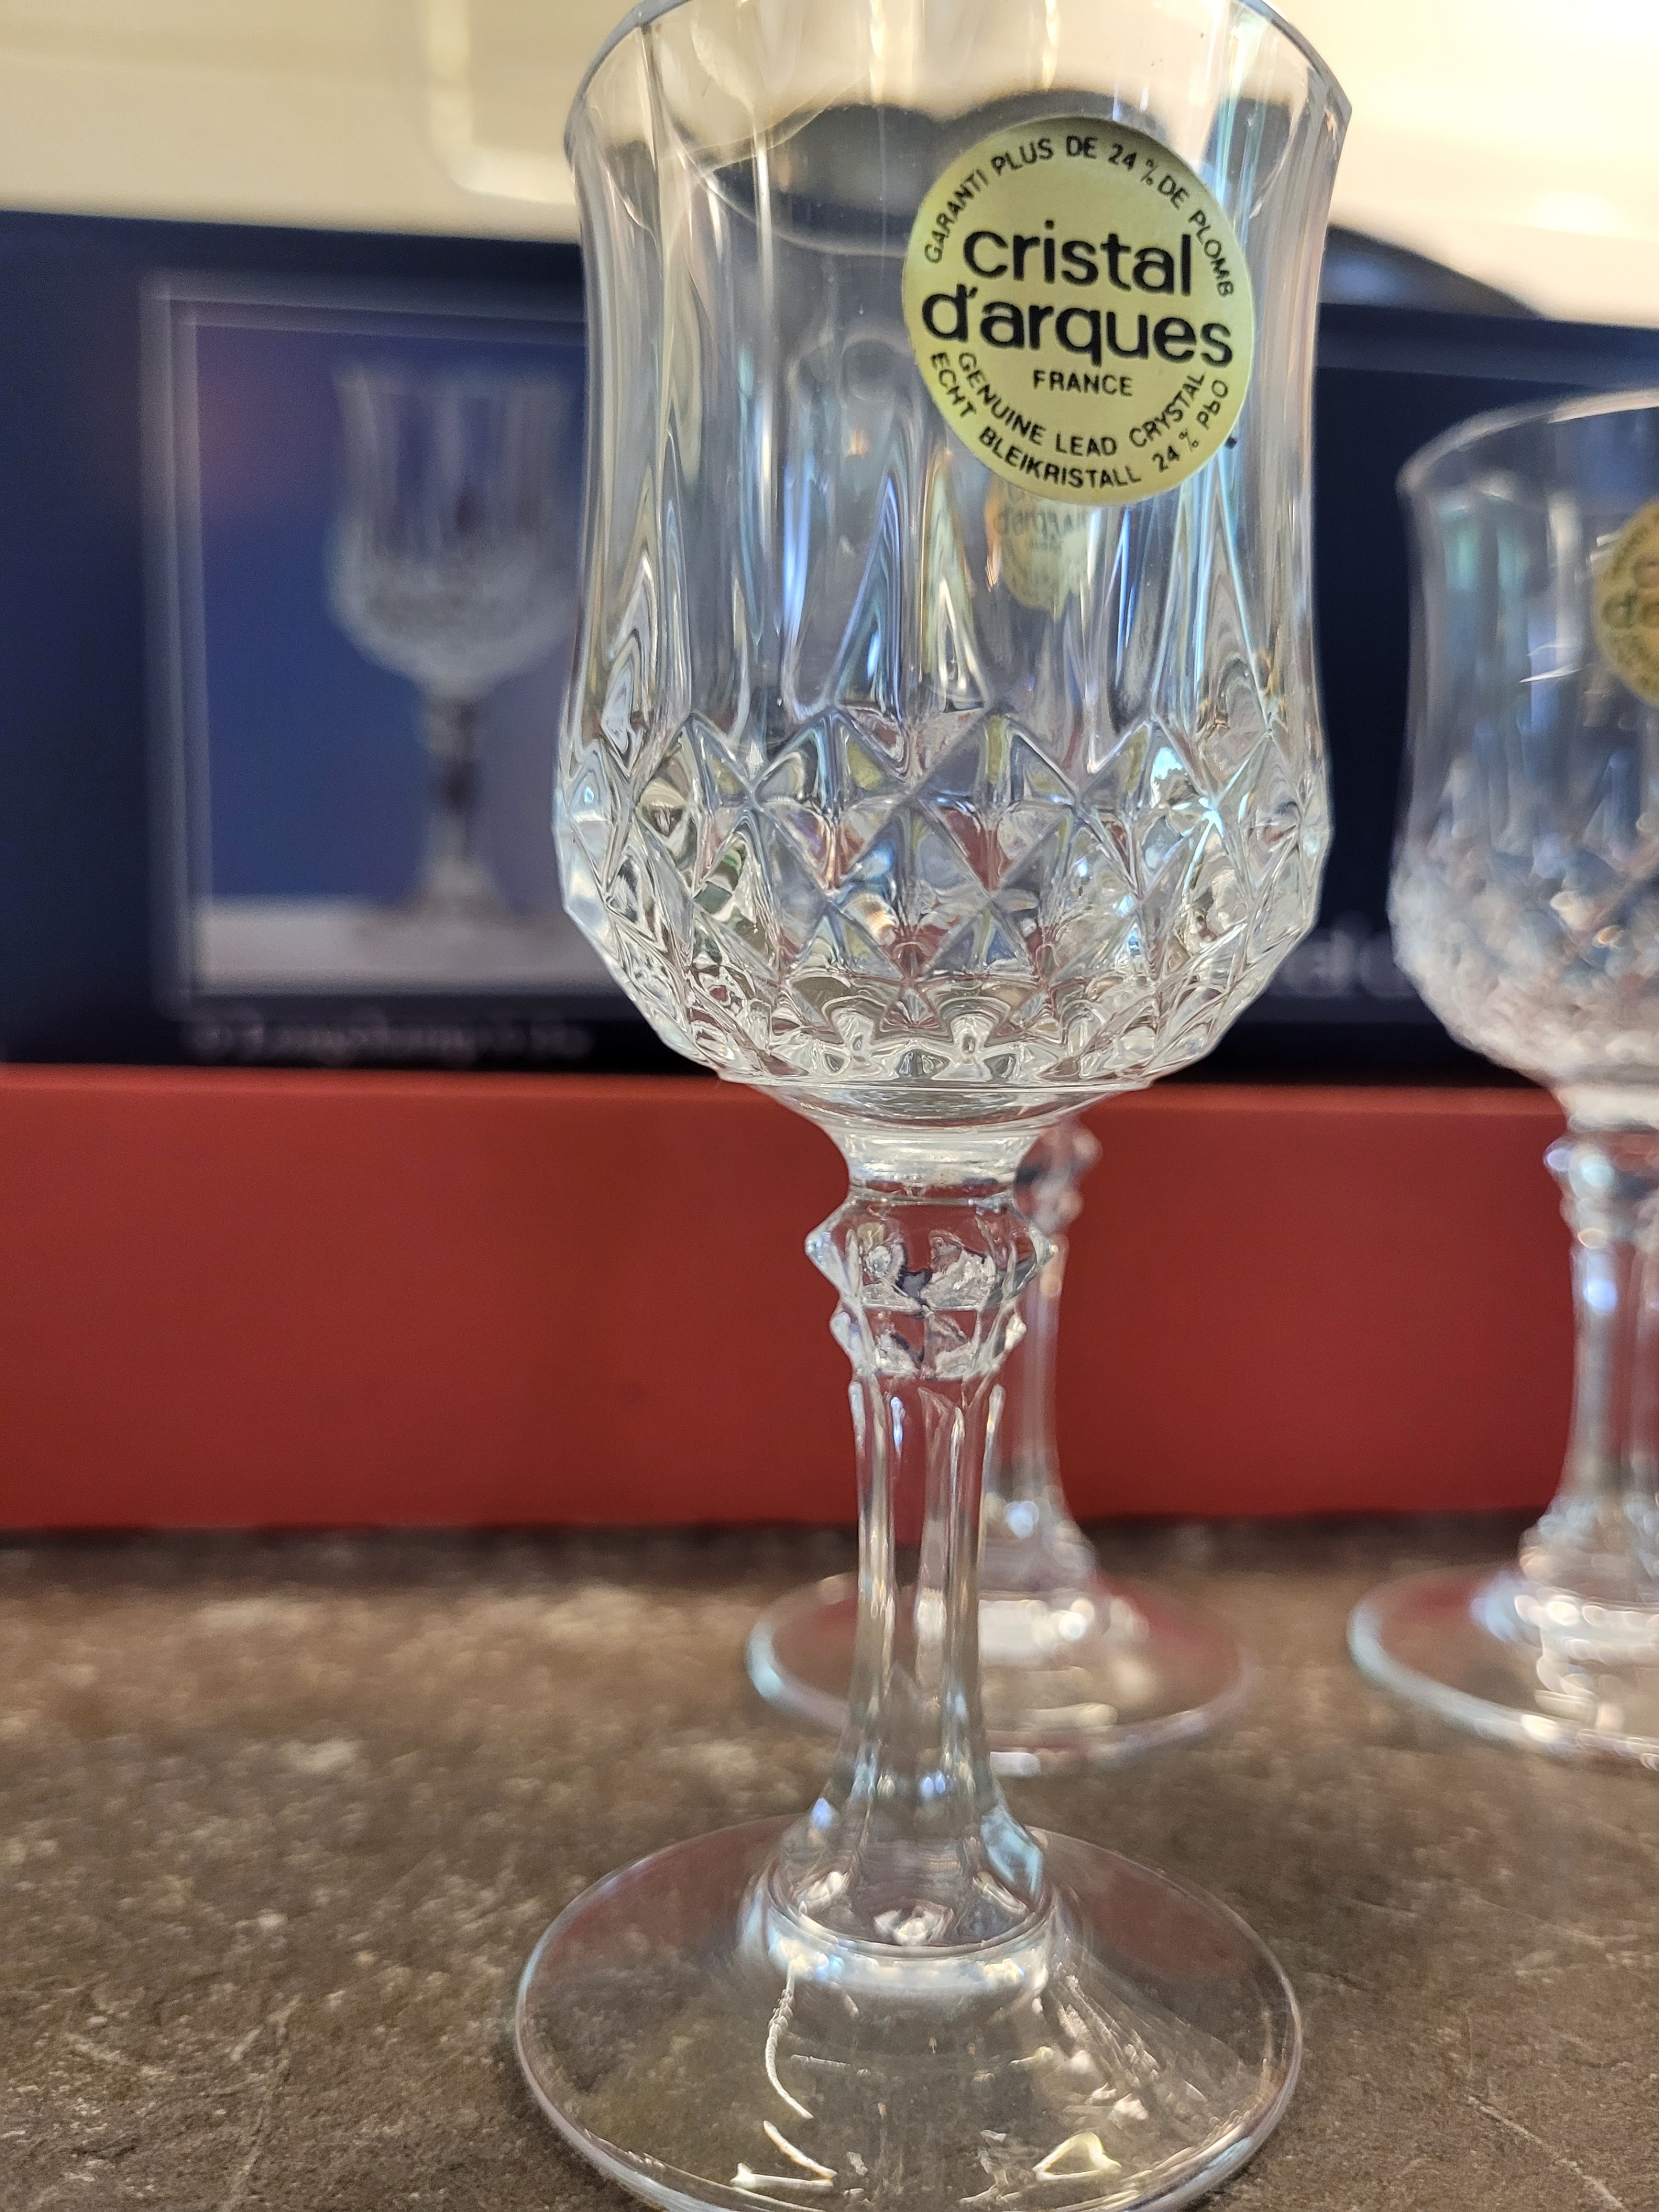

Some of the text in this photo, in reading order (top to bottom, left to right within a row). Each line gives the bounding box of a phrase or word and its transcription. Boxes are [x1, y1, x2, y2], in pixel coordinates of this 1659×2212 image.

[924, 169, 989, 263] GARANTI
[991, 138, 1054, 177] PLUS
[1066, 136, 1098, 159] DE
[1156, 174, 1191, 211] DE
[1187, 209, 1234, 297] PLOMB
[962, 219, 1192, 297] cristal
[922, 284, 1233, 368] d'arques
[929, 351, 977, 418] ECHT
[979, 426, 1142, 489] BLEIKRISTALL
[1195, 379, 1229, 431] PbO
[958, 351, 1206, 457] GENUINE LEAD CRYSTAL
[1032, 369, 1133, 397] FRANCE
